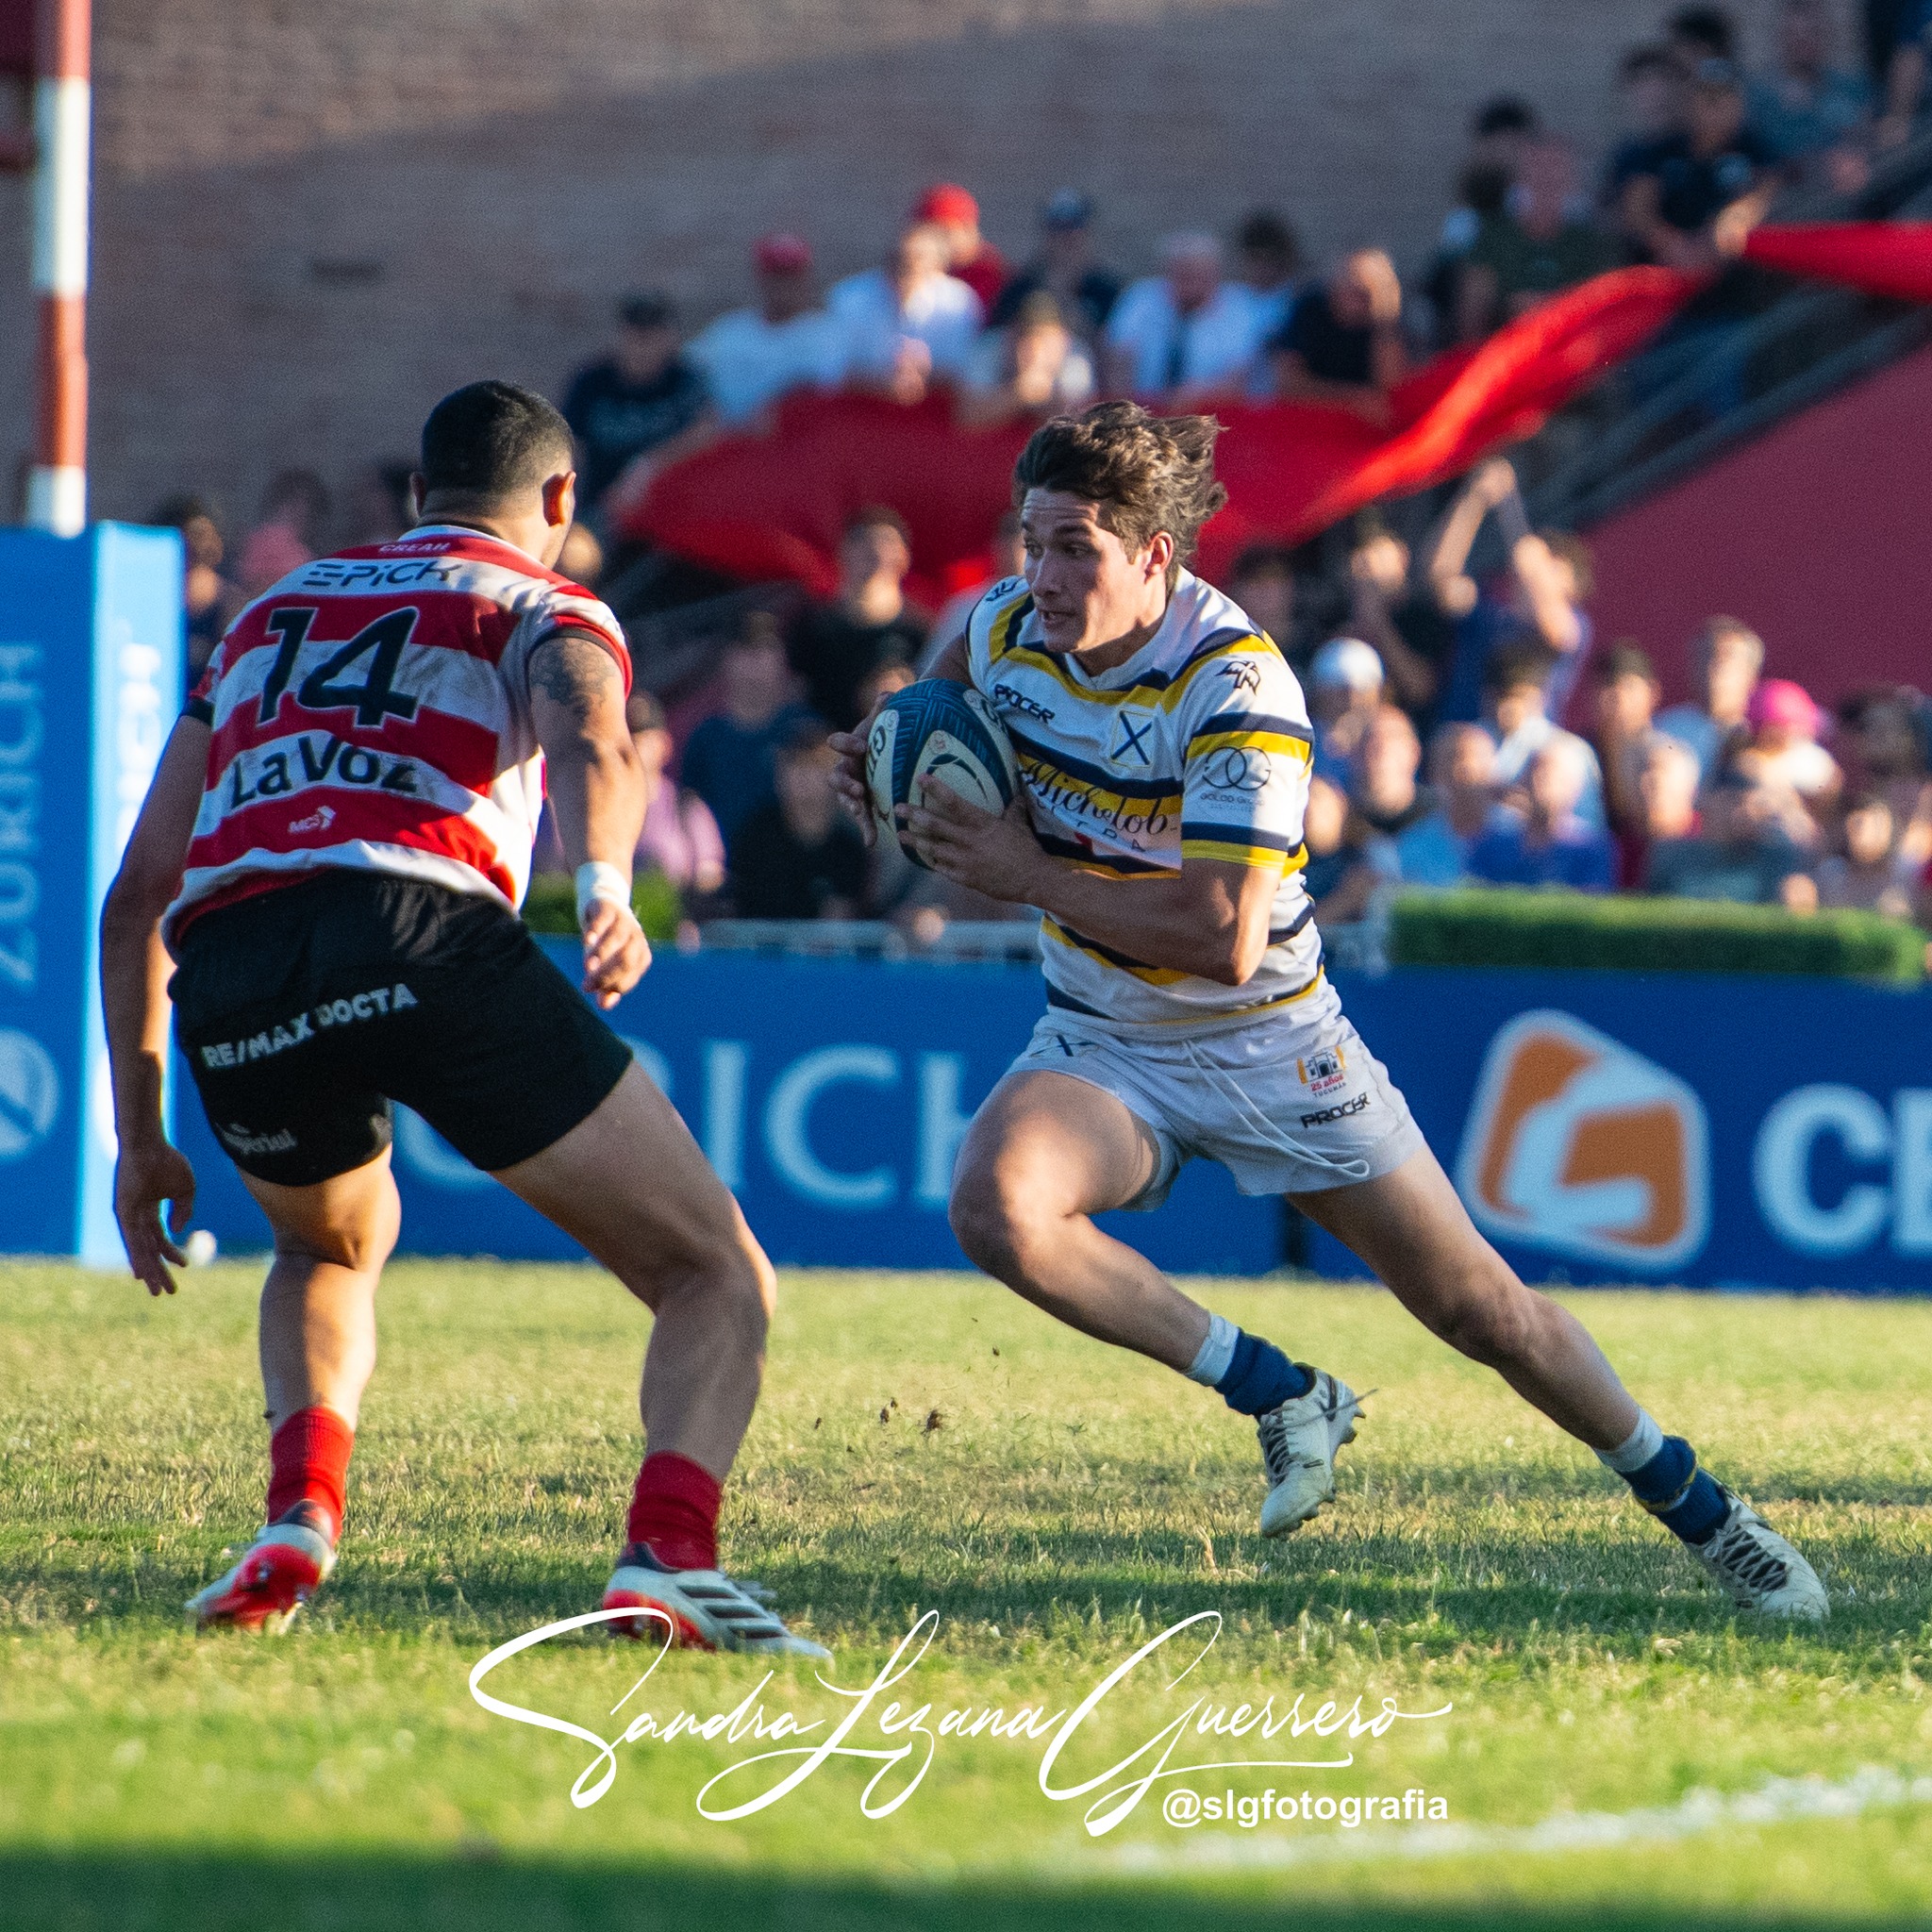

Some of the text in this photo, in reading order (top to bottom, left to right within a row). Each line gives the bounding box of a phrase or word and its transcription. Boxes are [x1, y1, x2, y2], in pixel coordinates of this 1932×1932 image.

[257, 606, 421, 729] 14
[993, 683, 1057, 724] PROCER
[1022, 761, 1169, 836] Michelob
[201, 982, 420, 1068] RE/MAX DOCTA
[1300, 1091, 1372, 1129] PROCER
[1310, 1081, 1323, 1092] 25
